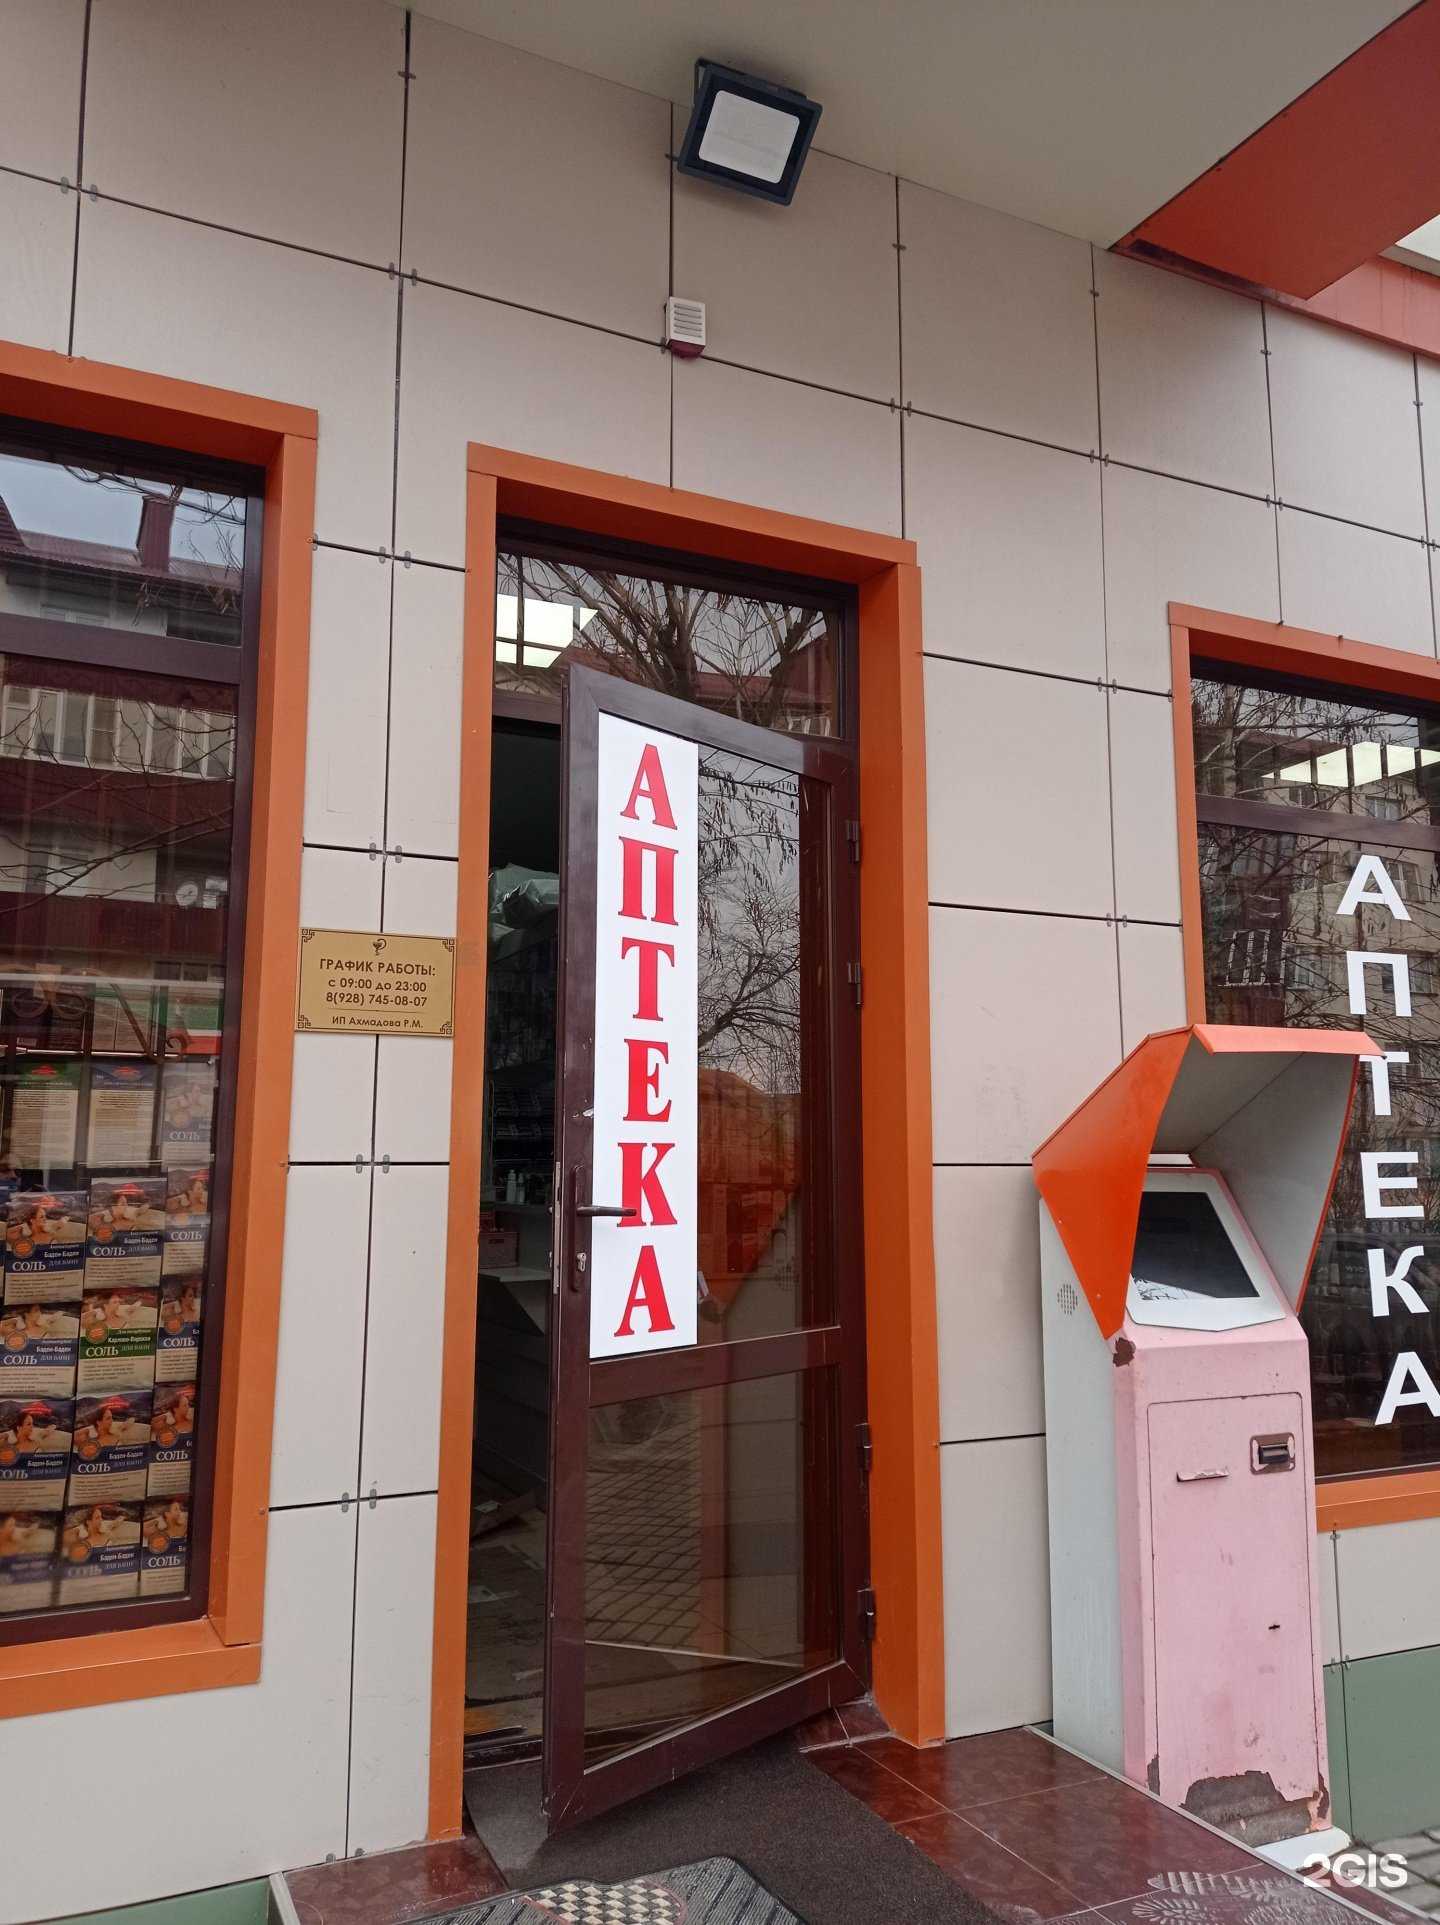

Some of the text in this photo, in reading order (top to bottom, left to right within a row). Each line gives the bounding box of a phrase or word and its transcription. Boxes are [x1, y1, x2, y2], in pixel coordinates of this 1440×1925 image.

[319, 958, 436, 977] ГРАФИК РАБОТЫ:
[328, 977, 427, 992] с 09:00 до 23:00
[326, 992, 428, 1007] 8(928) 745-08-07
[332, 1016, 424, 1029] ИП Ахмадова Р.М.
[613, 742, 677, 1337] АПТЕКА
[1336, 854, 1440, 1427] АПТЕКА
[170, 1231, 202, 1241] СОЛЬ
[92, 1247, 126, 1257] СОЛЬ
[12, 1261, 46, 1272] СОЛЬ
[163, 1337, 195, 1348] СОЛЬ
[86, 1346, 119, 1357] СОЛЬ
[3, 1355, 38, 1365] СОЛЬ
[156, 1450, 188, 1461] СОЛЬ
[77, 1463, 111, 1474] СОЛЬ
[148, 1556, 181, 1568] СОЛЬ
